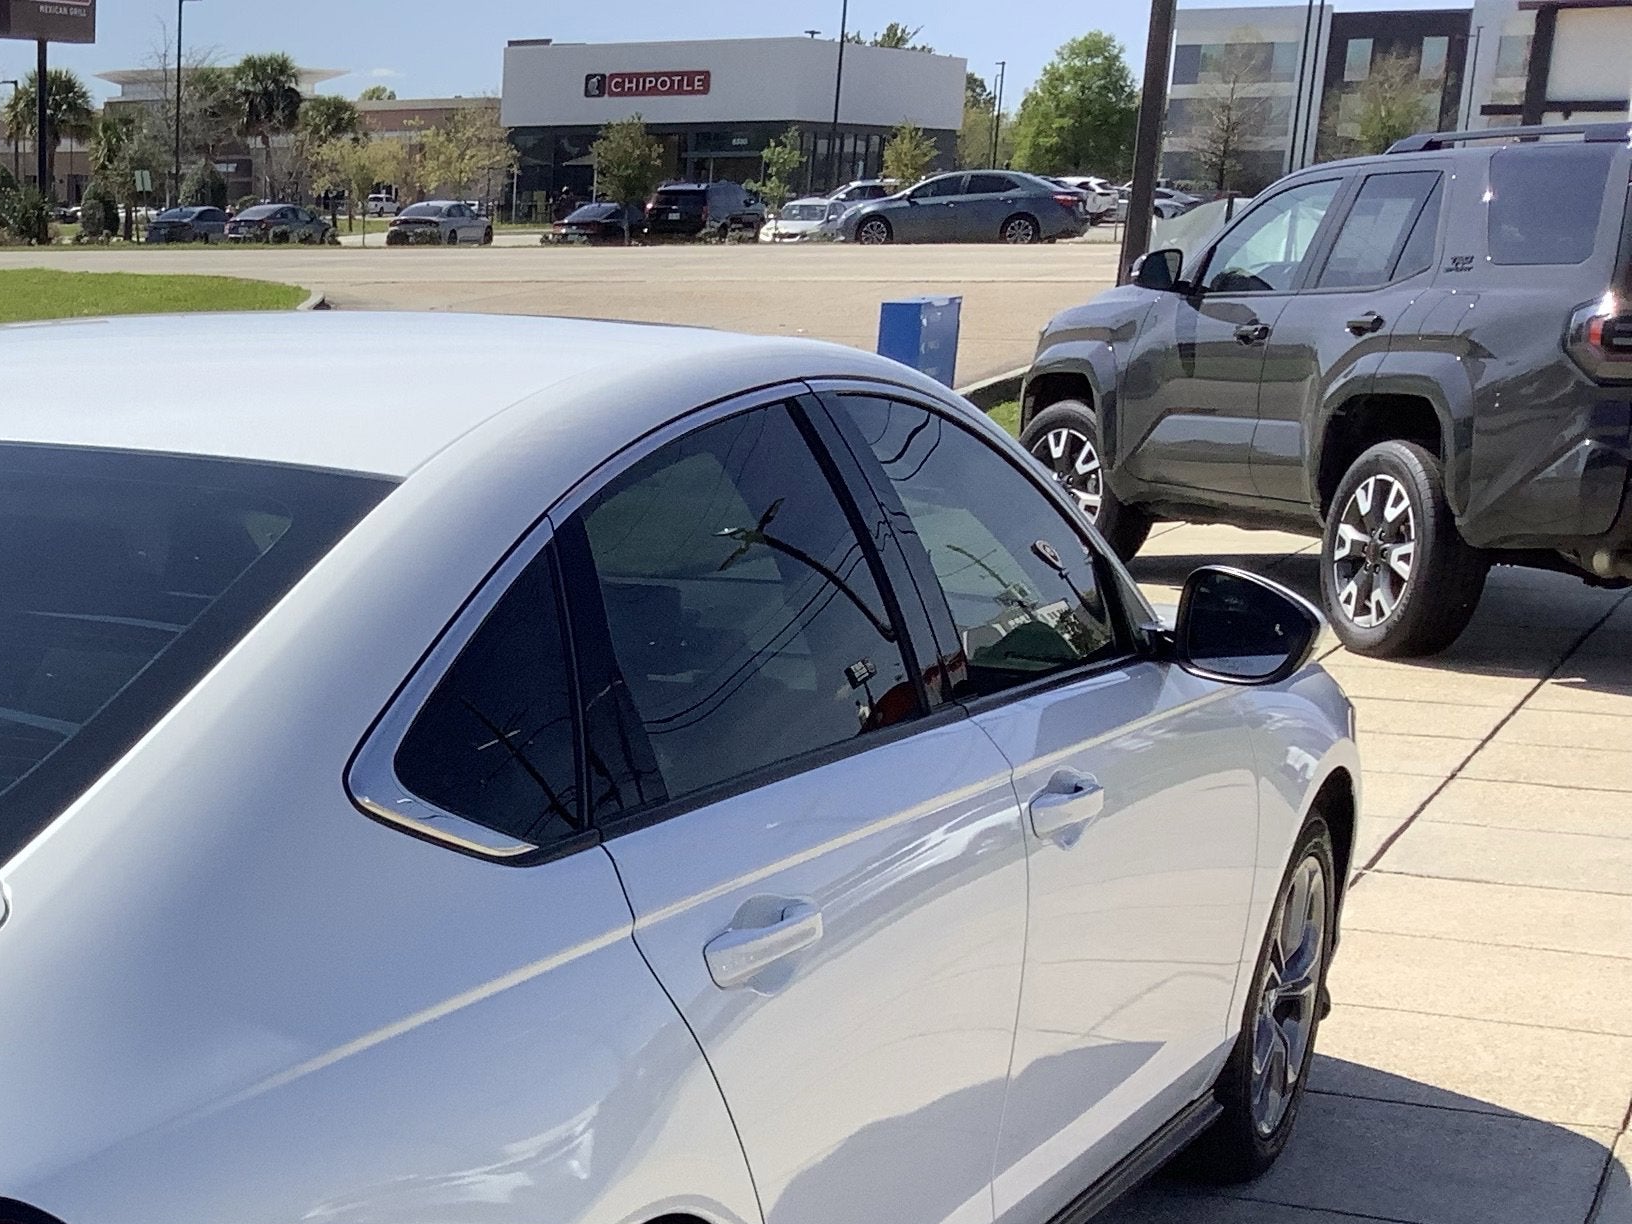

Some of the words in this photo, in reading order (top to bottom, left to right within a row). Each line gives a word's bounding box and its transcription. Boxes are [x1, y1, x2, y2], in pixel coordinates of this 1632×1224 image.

[39, 4, 68, 15] MEXICAN
[69, 7, 86, 17] GRILL
[611, 75, 705, 92] CHIPOTLE
